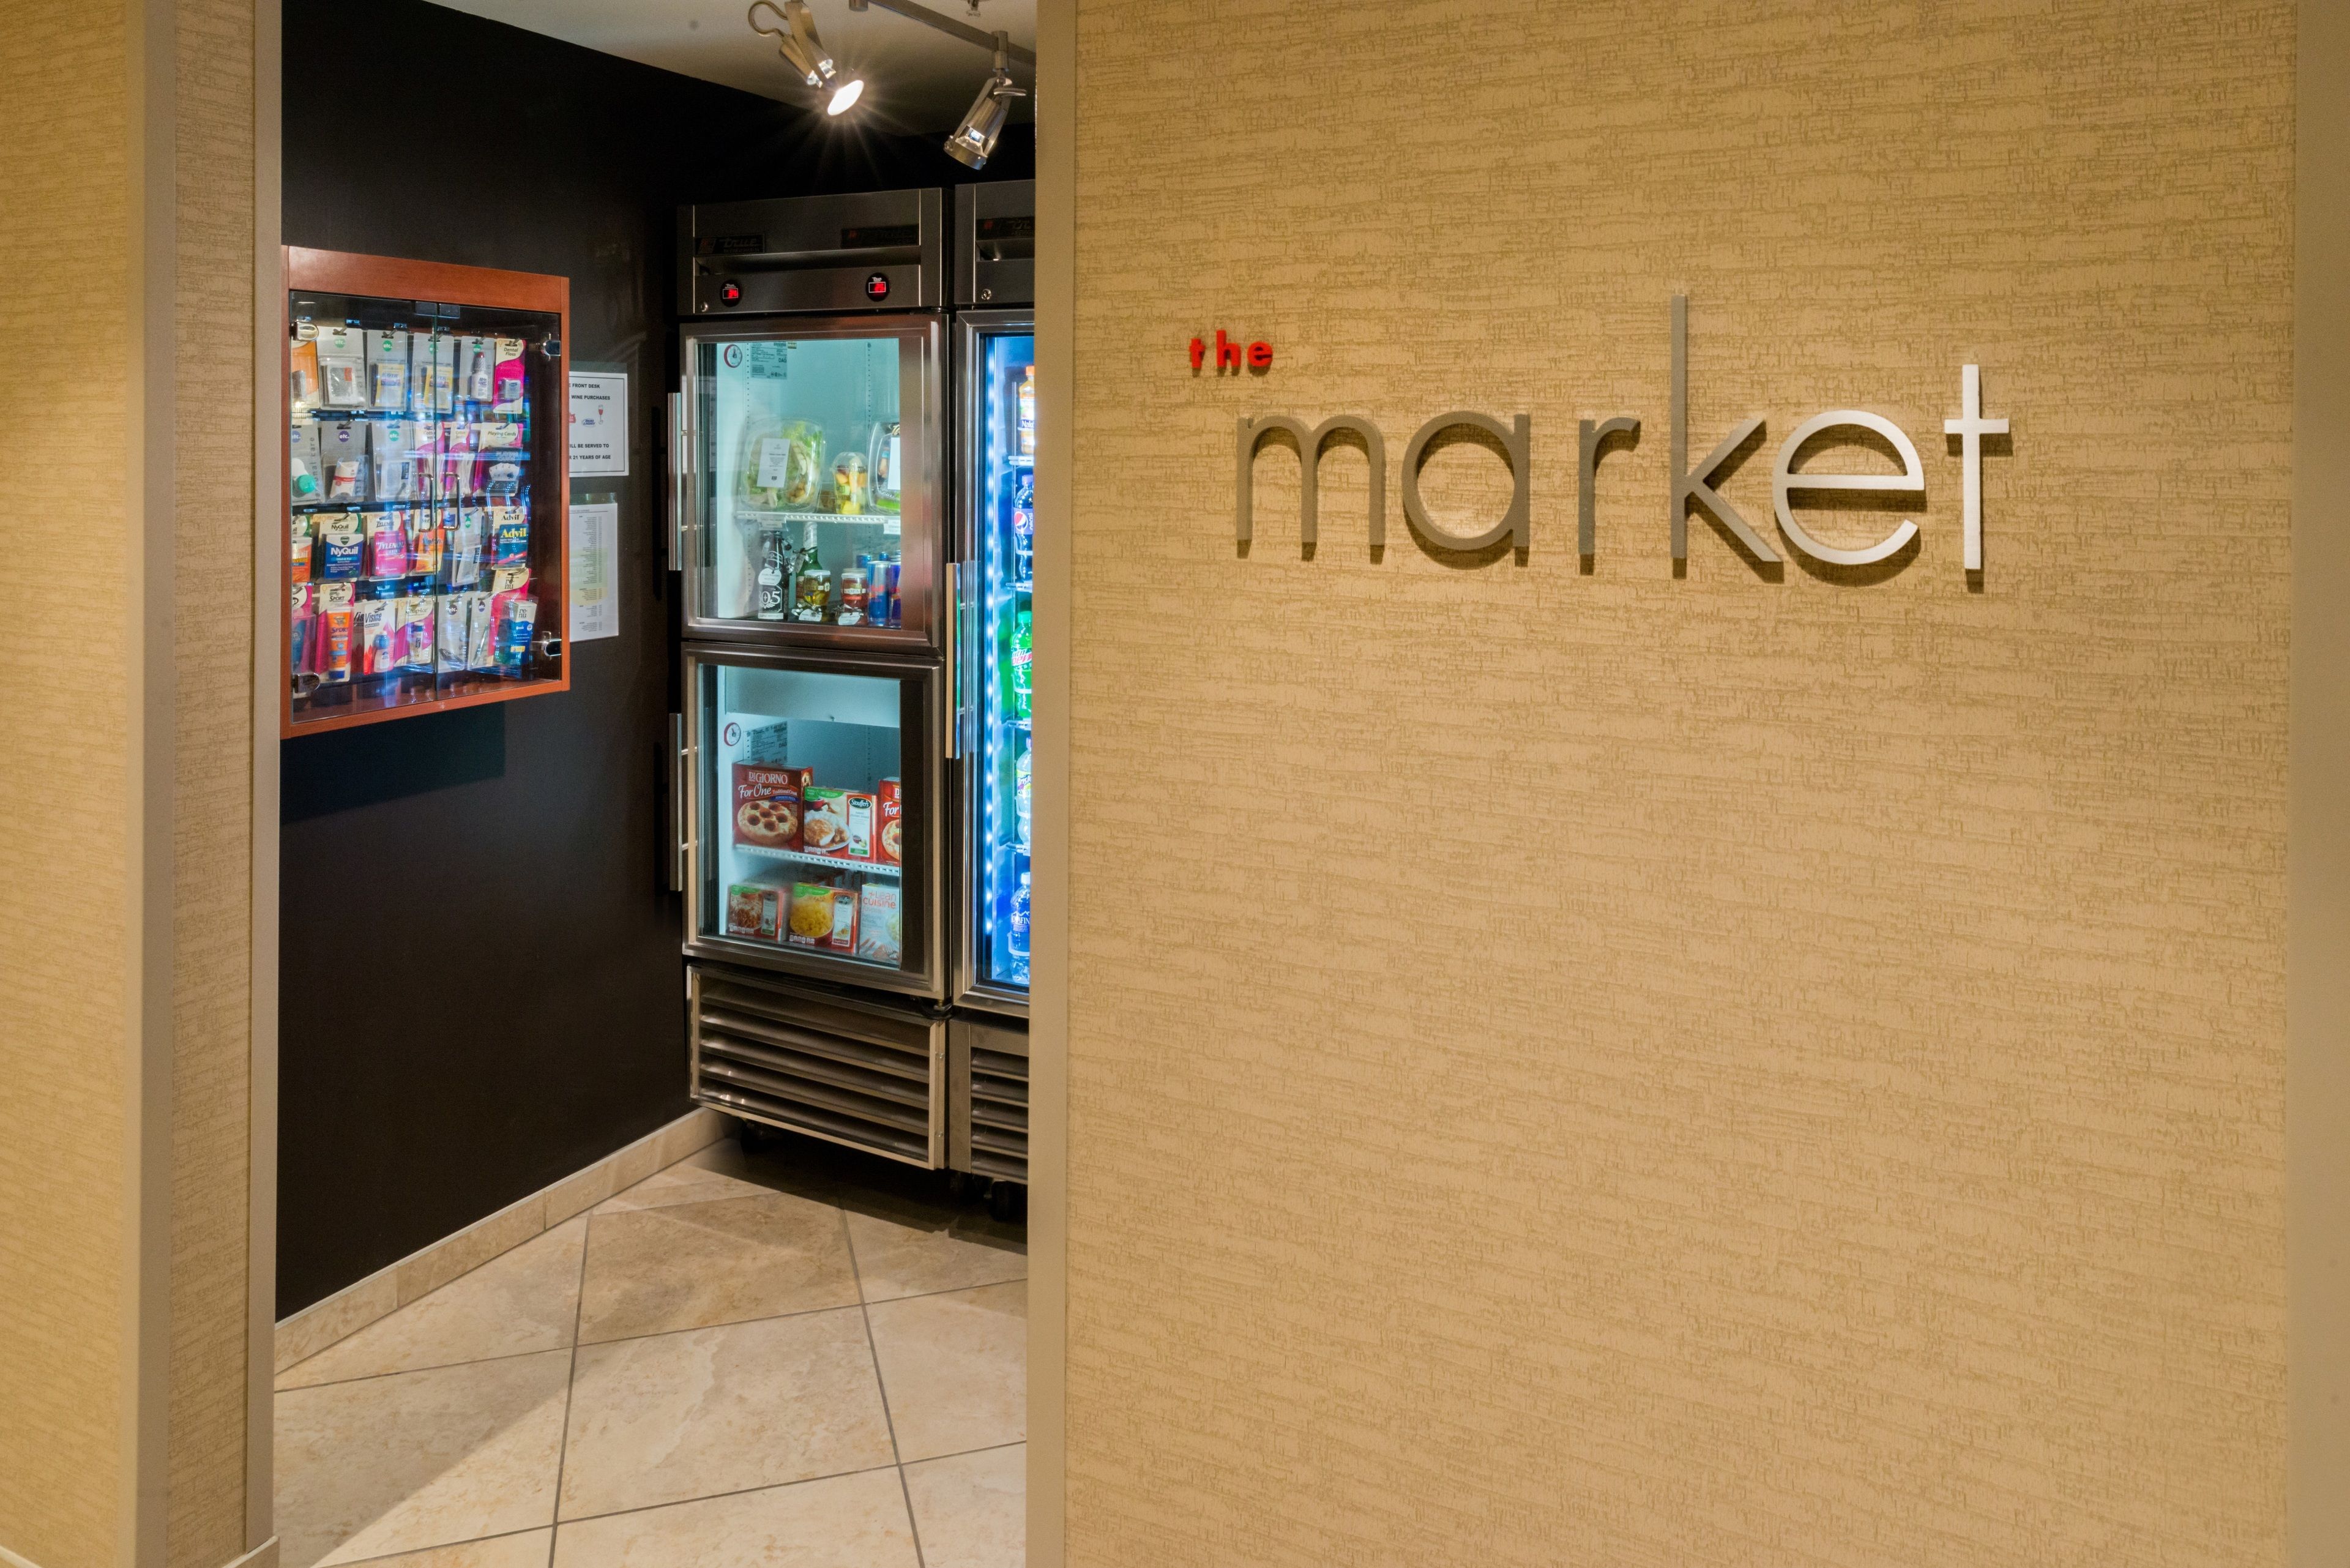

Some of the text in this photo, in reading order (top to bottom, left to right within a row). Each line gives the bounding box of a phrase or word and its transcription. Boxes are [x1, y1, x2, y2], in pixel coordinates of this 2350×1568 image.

[1188, 330, 1274, 370] the
[1236, 294, 2010, 570] market
[500, 527, 528, 538] Advil
[330, 547, 359, 556] NyQuil
[365, 612, 382, 623] Visine
[738, 784, 753, 799] For
[753, 783, 772, 797] One
[851, 799, 869, 807] Stouffer's
[883, 801, 900, 817] For
[875, 890, 897, 902] Lean
